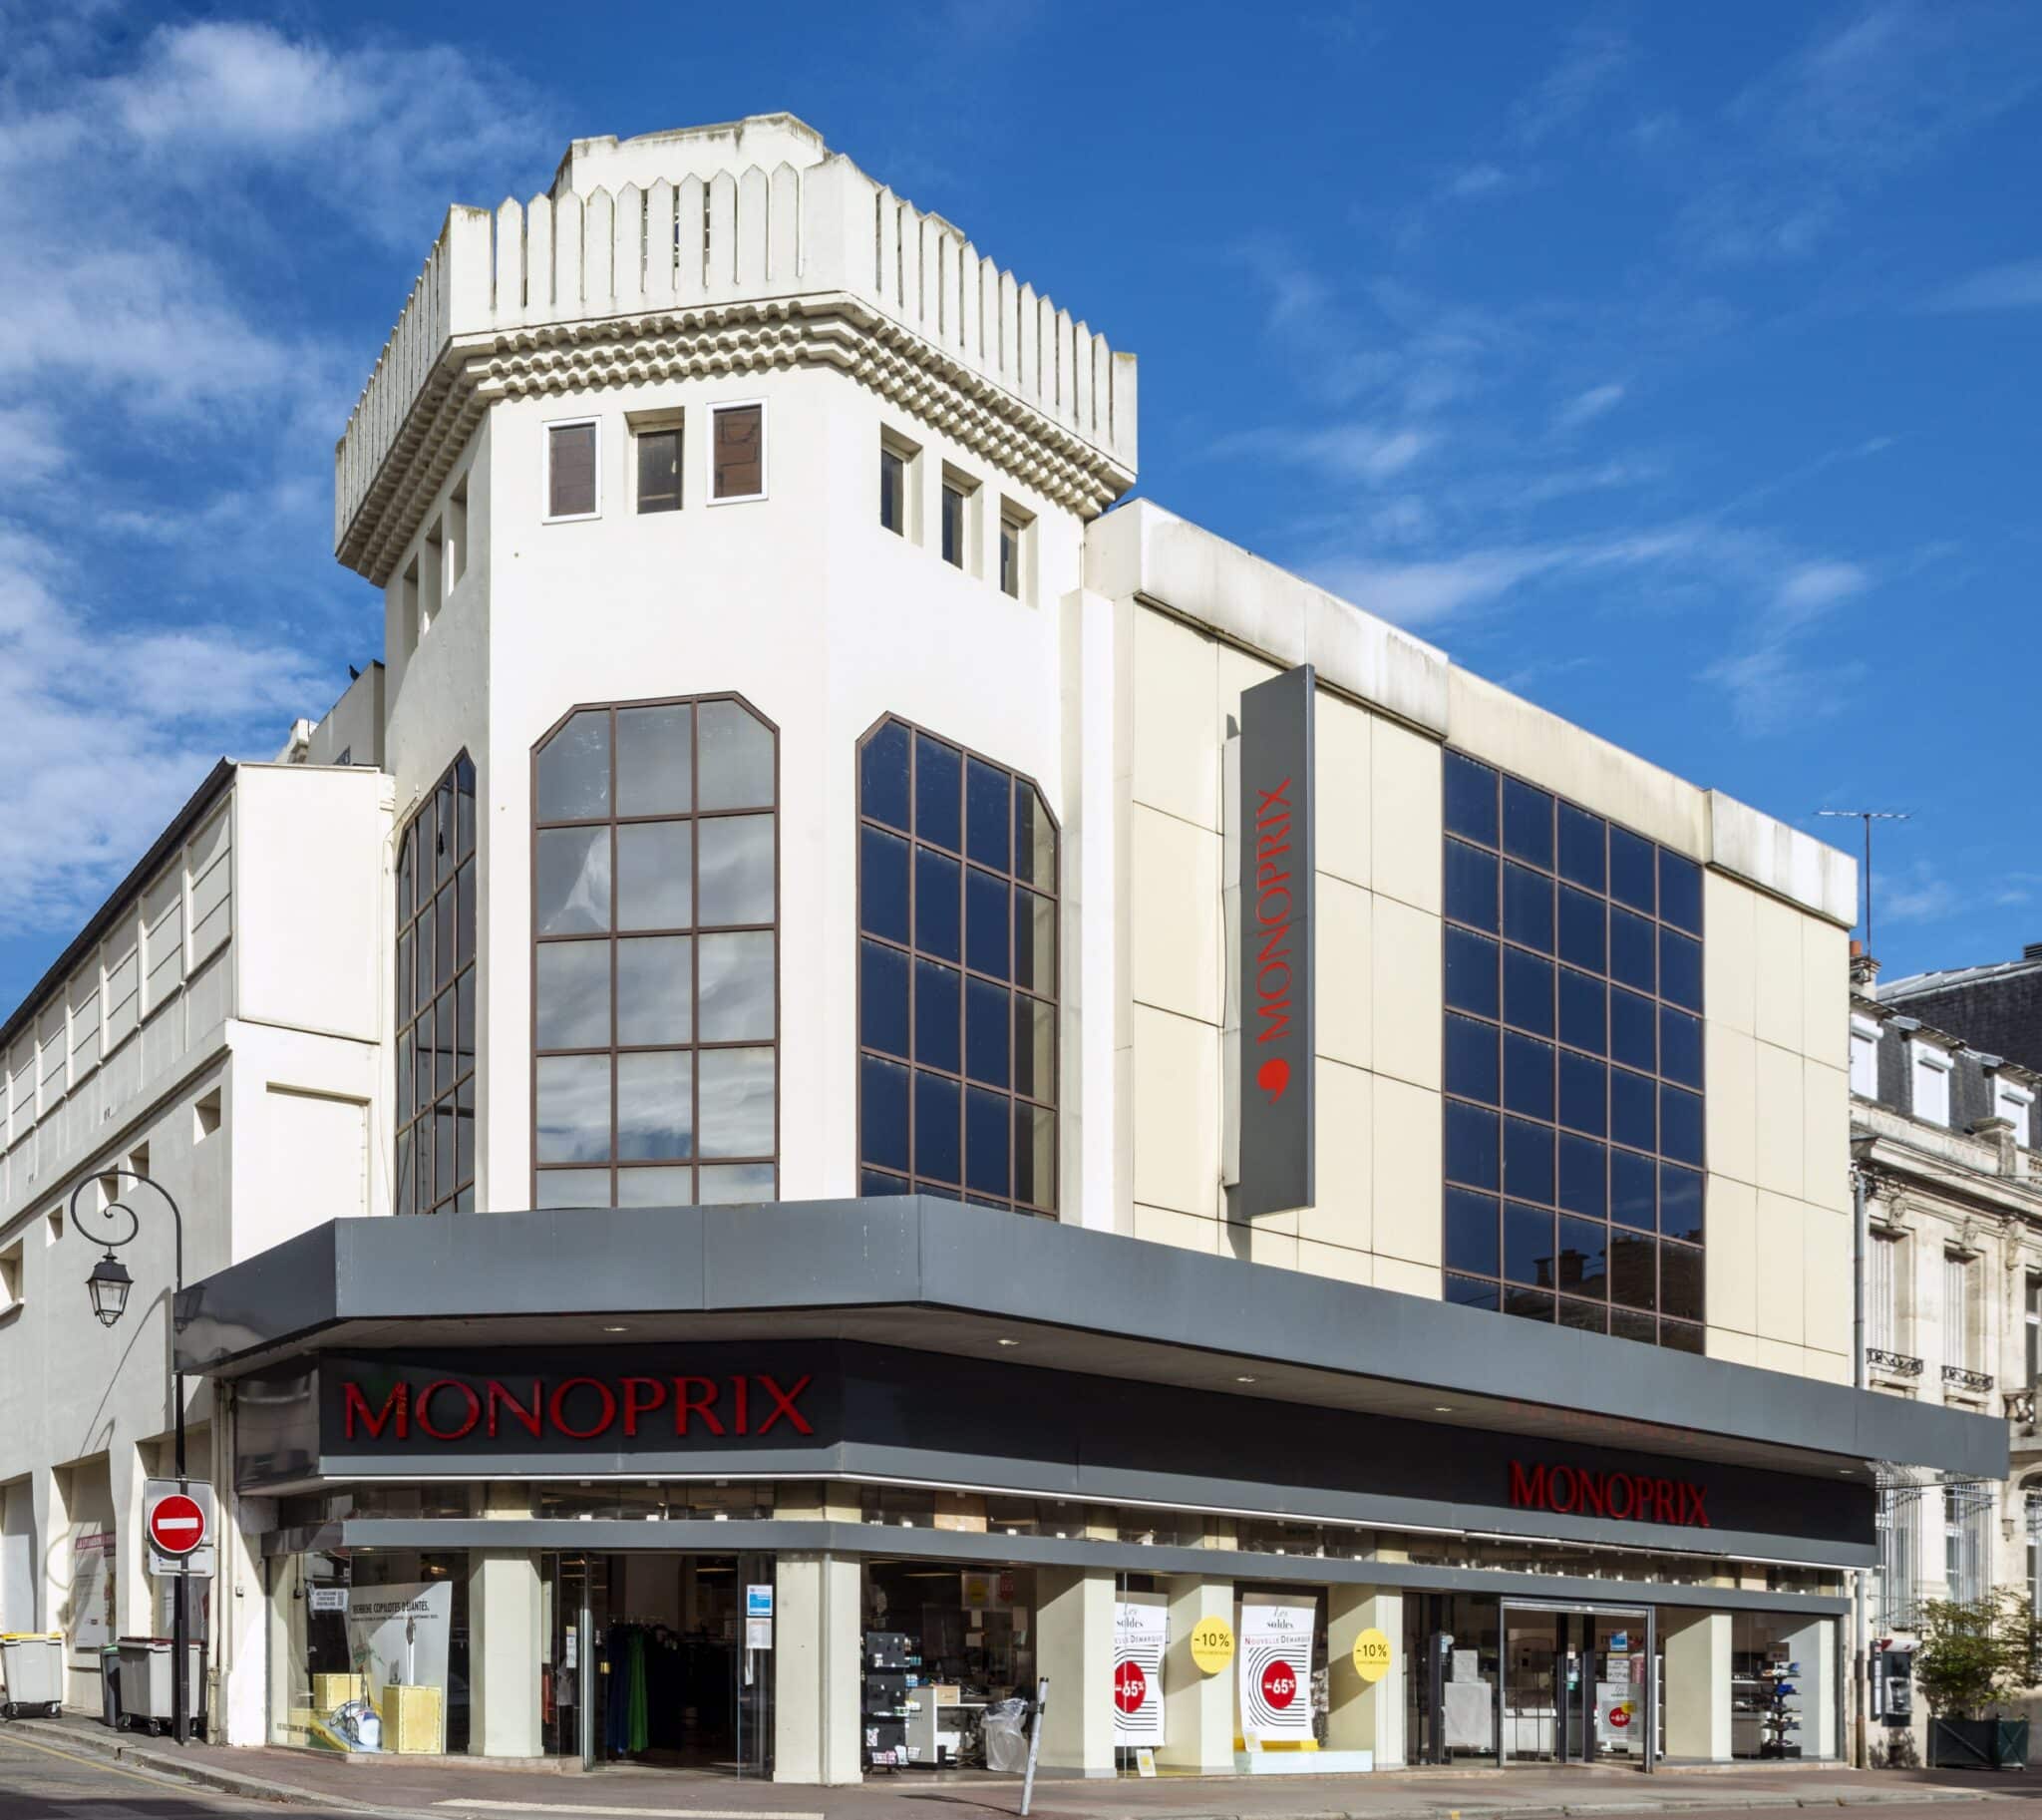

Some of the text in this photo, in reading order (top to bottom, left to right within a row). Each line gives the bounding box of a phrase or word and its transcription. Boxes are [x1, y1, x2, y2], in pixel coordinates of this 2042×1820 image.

[1256, 777, 1292, 1045] MONOPRIX
[342, 1374, 815, 1439] MONOPRIX
[1510, 1460, 1710, 1528] MONOPRIX
[1117, 1618, 1144, 1628] soldes
[1267, 1619, 1294, 1629] soldes
[1194, 1634, 1229, 1647] -10%
[1356, 1644, 1387, 1656] -10%
[1115, 1680, 1145, 1697] -65%
[1264, 1679, 1294, 1693] -65%
